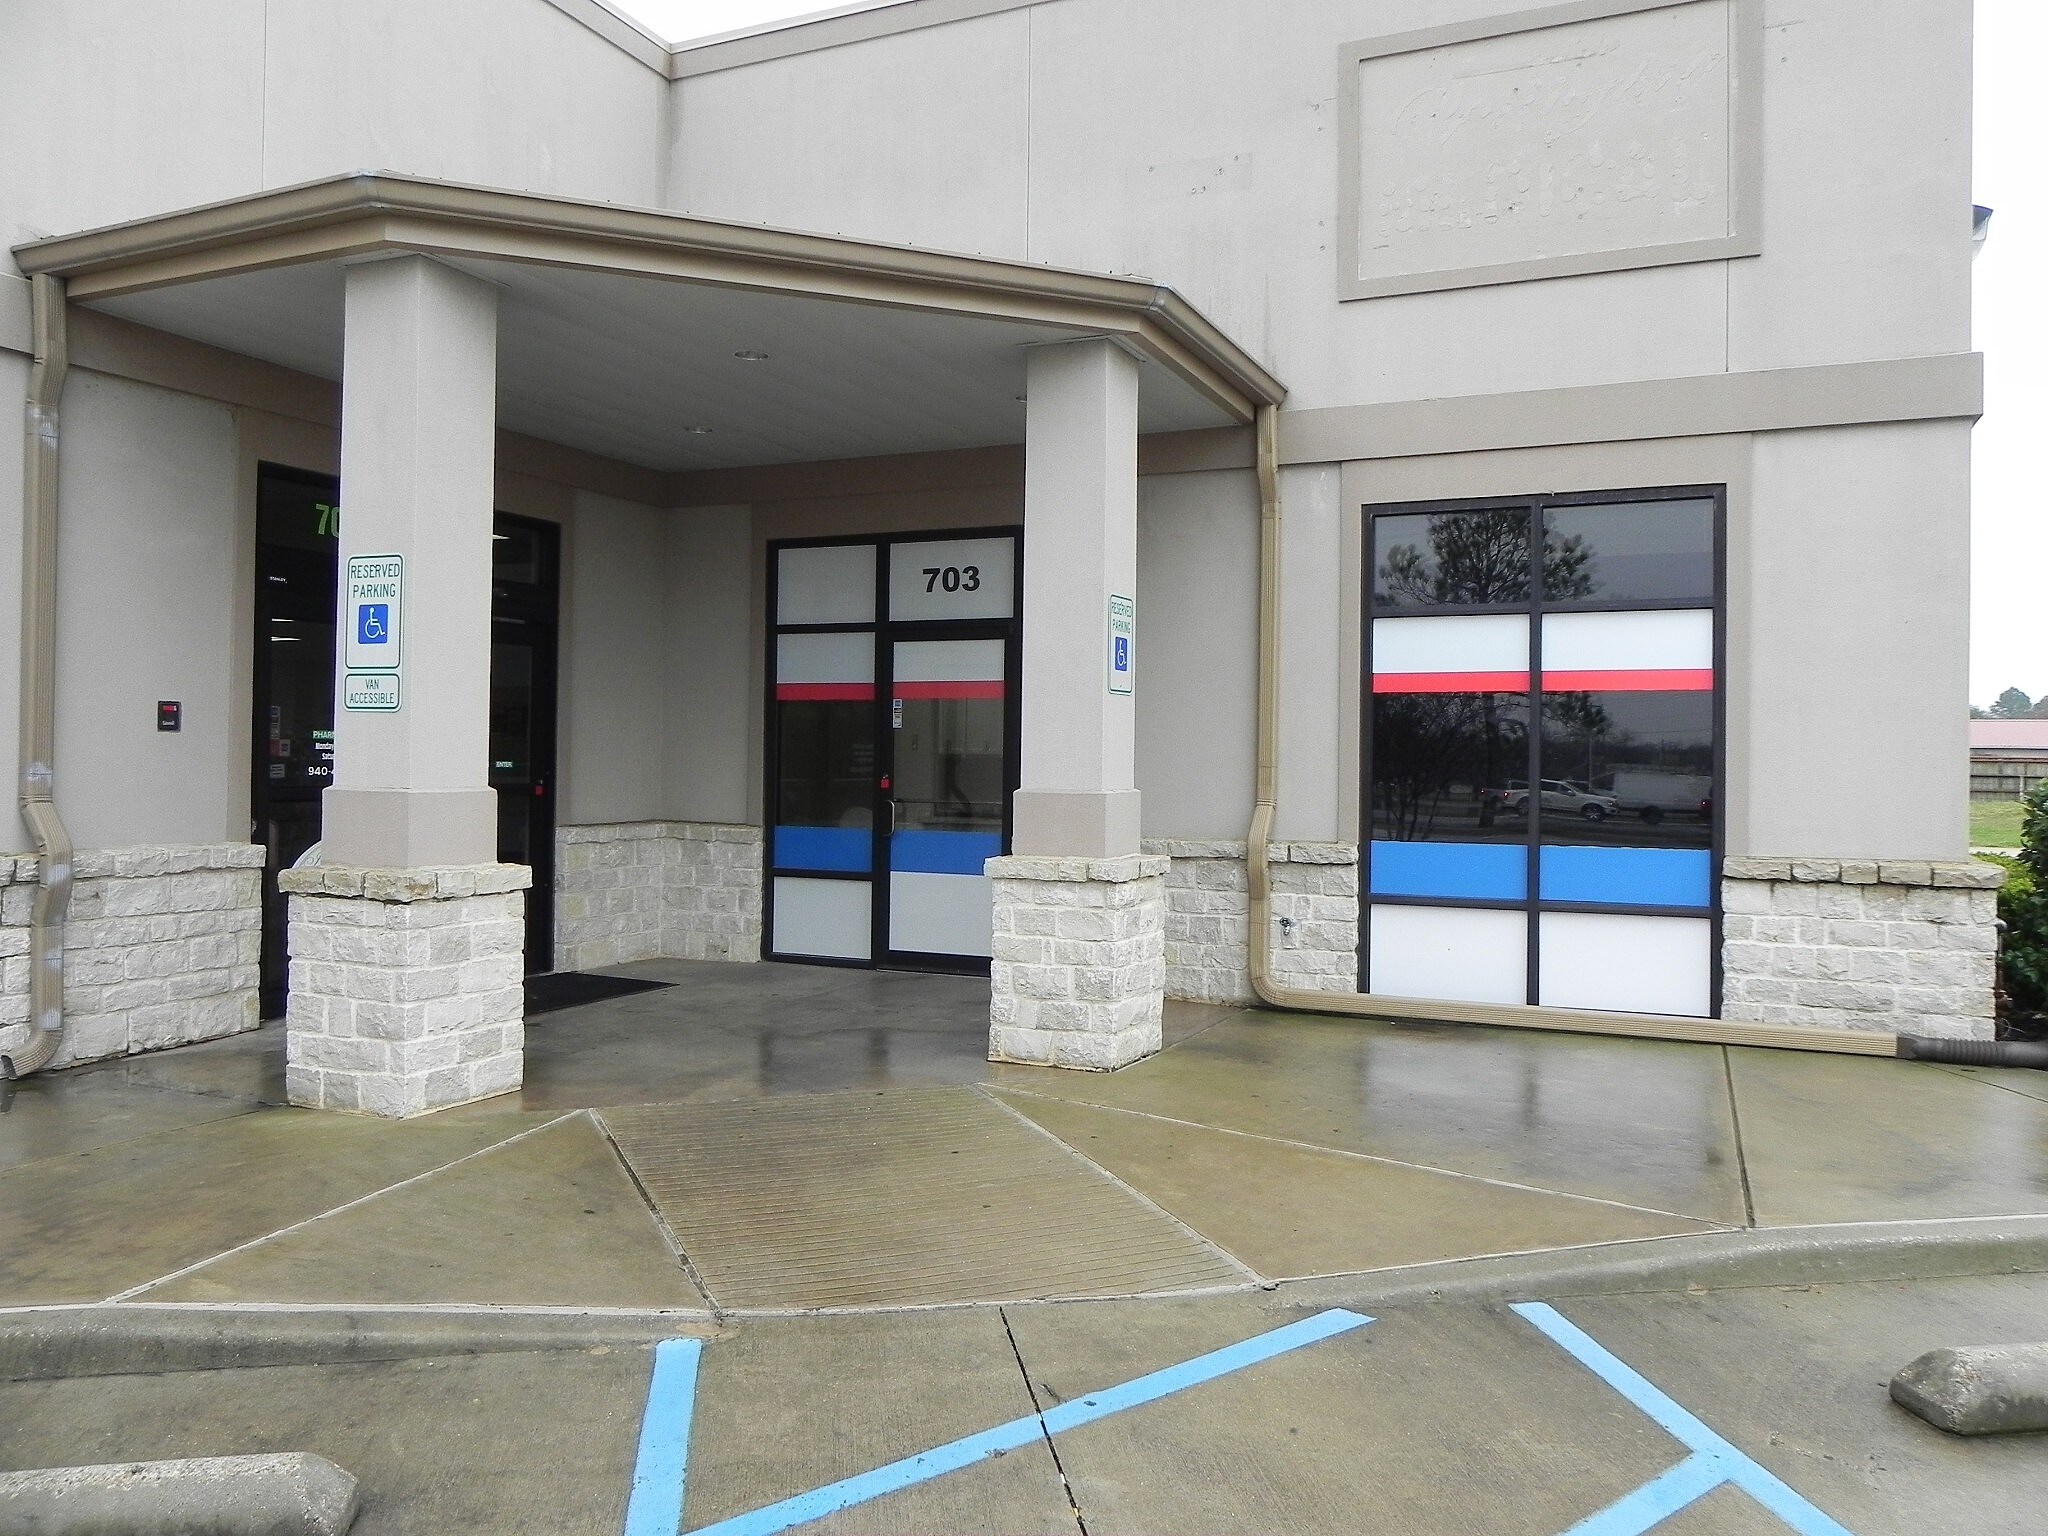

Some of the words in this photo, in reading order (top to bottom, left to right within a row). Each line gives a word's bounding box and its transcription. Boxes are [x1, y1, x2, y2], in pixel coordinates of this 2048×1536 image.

[350, 563, 401, 579] RESERVED
[922, 565, 980, 593] 703
[352, 583, 397, 598] PARKING
[365, 679, 380, 690] VAN
[349, 692, 395, 704] ACCESSIBLE
